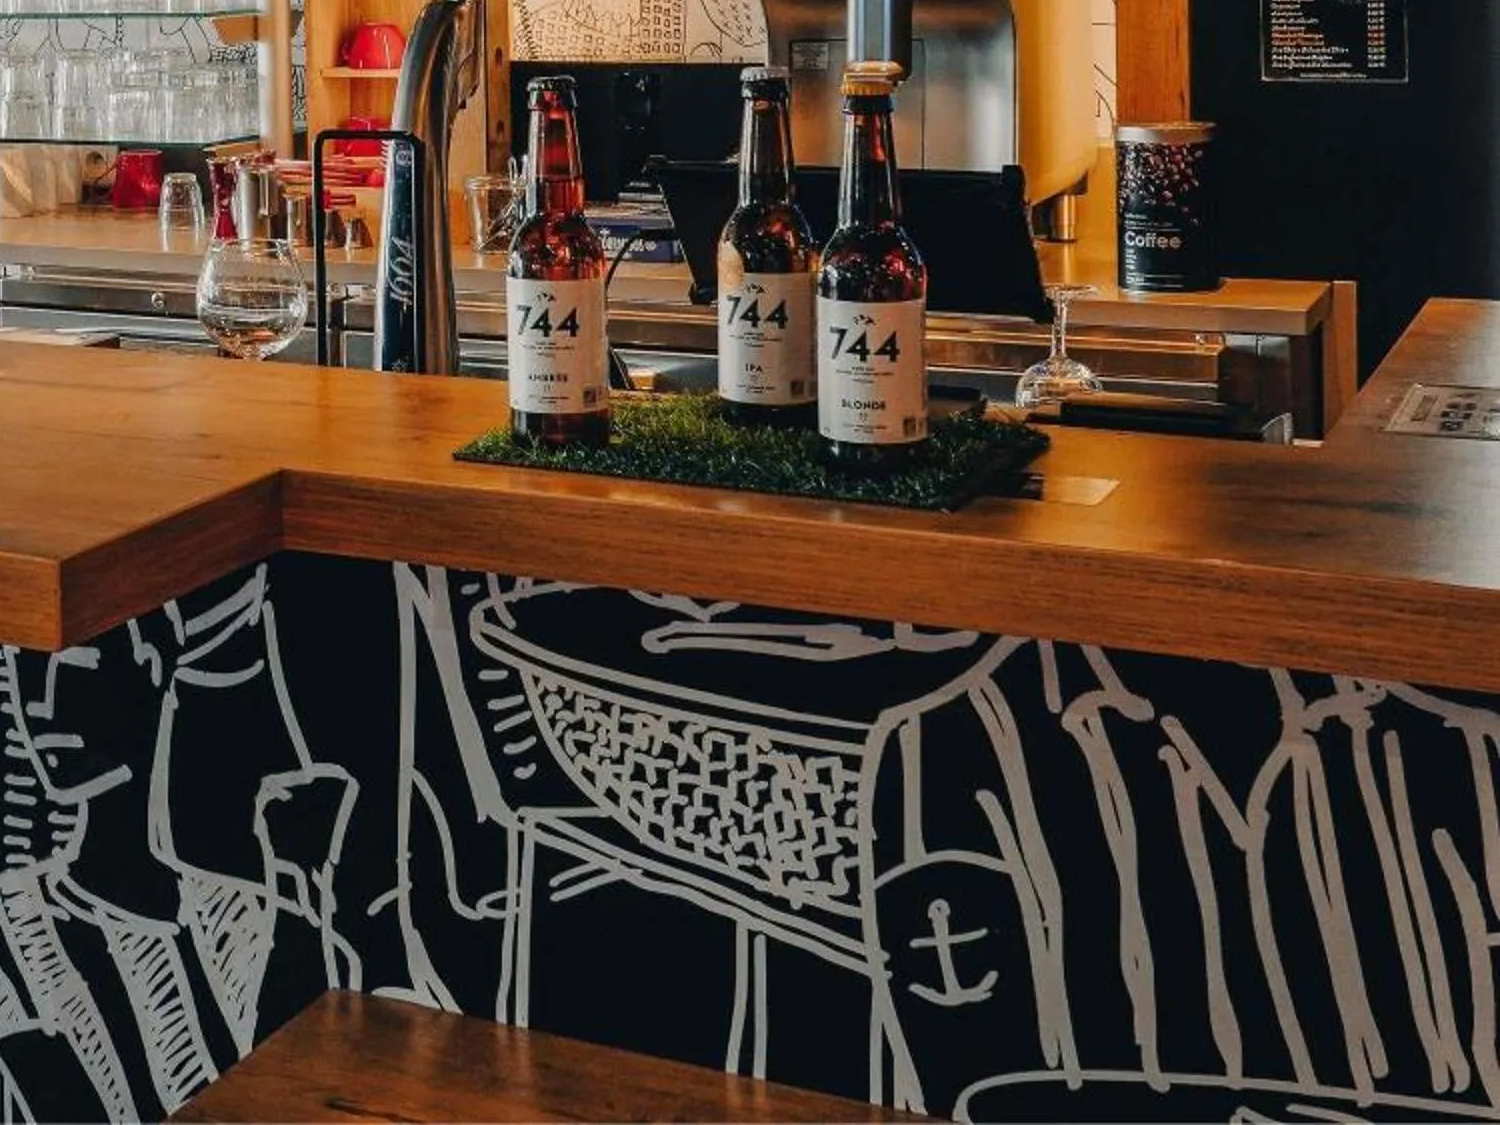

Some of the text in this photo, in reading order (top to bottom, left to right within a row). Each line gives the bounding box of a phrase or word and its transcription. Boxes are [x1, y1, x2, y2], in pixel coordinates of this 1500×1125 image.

[1124, 230, 1182, 249] Coffee
[516, 305, 581, 338] 744
[727, 295, 789, 329] 744
[829, 326, 901, 363] 744
[744, 362, 763, 372] IPA
[841, 398, 886, 410] BLONDE
